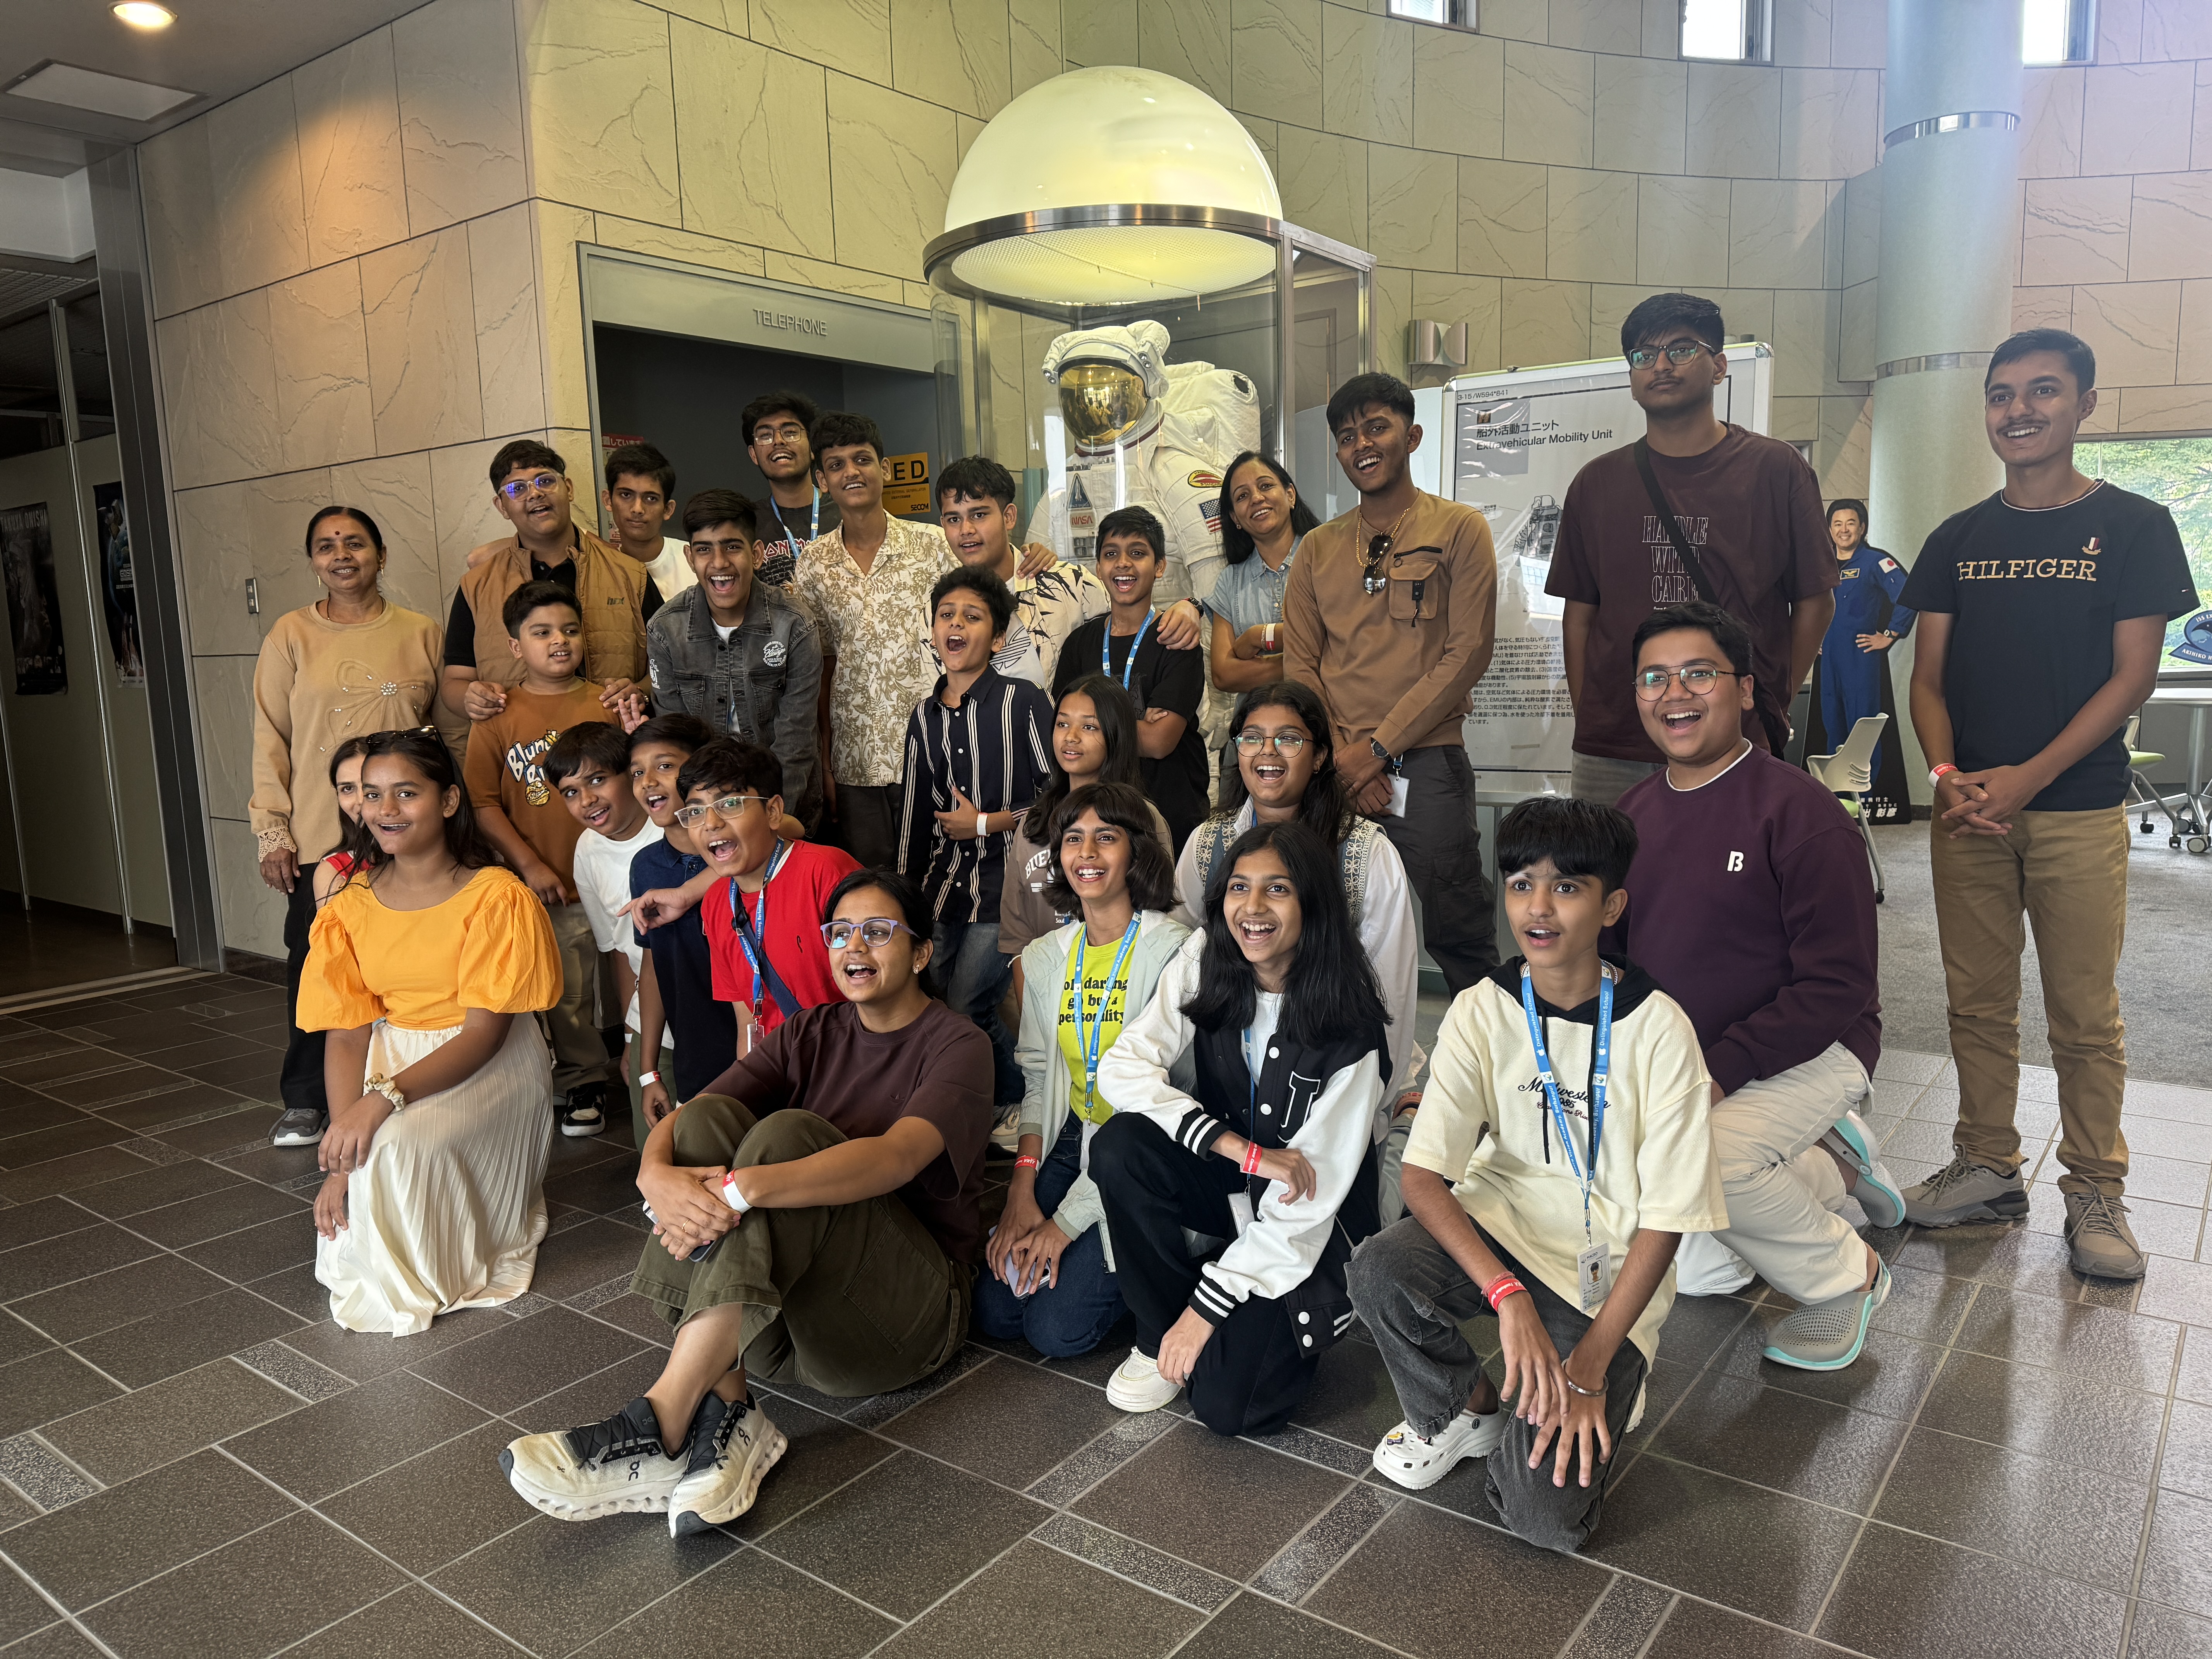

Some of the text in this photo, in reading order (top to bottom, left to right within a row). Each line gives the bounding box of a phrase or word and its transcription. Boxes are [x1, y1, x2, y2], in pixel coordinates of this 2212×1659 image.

[754, 309, 828, 336] TELEPHONE
[1477, 429, 1613, 450] Extravehicular Mobility Unit
[893, 460, 925, 481] ED
[911, 503, 929, 511] SECOM
[1071, 515, 1093, 526] NASA
[1642, 516, 1709, 544] HADLE
[1651, 546, 1699, 573] WIT
[1957, 558, 2097, 581] HILFIGER
[2182, 648, 2206, 659] AKIHIKO
[1728, 851, 1744, 872] B
[1125, 922, 1137, 944] Burhanpur
[1084, 977, 1128, 991] darng
[1111, 996, 1118, 1005] a
[1530, 1011, 1541, 1047] Distinguished
[1599, 1009, 1608, 1046] Distinguished
[1518, 1076, 1611, 1108] Mwesten
[1548, 1085, 1559, 1113] Burhanpur
[1559, 1097, 1577, 1108] 985
[1593, 1087, 1601, 1116] Burhanpur
[1558, 1115, 1568, 1140] Academy,
